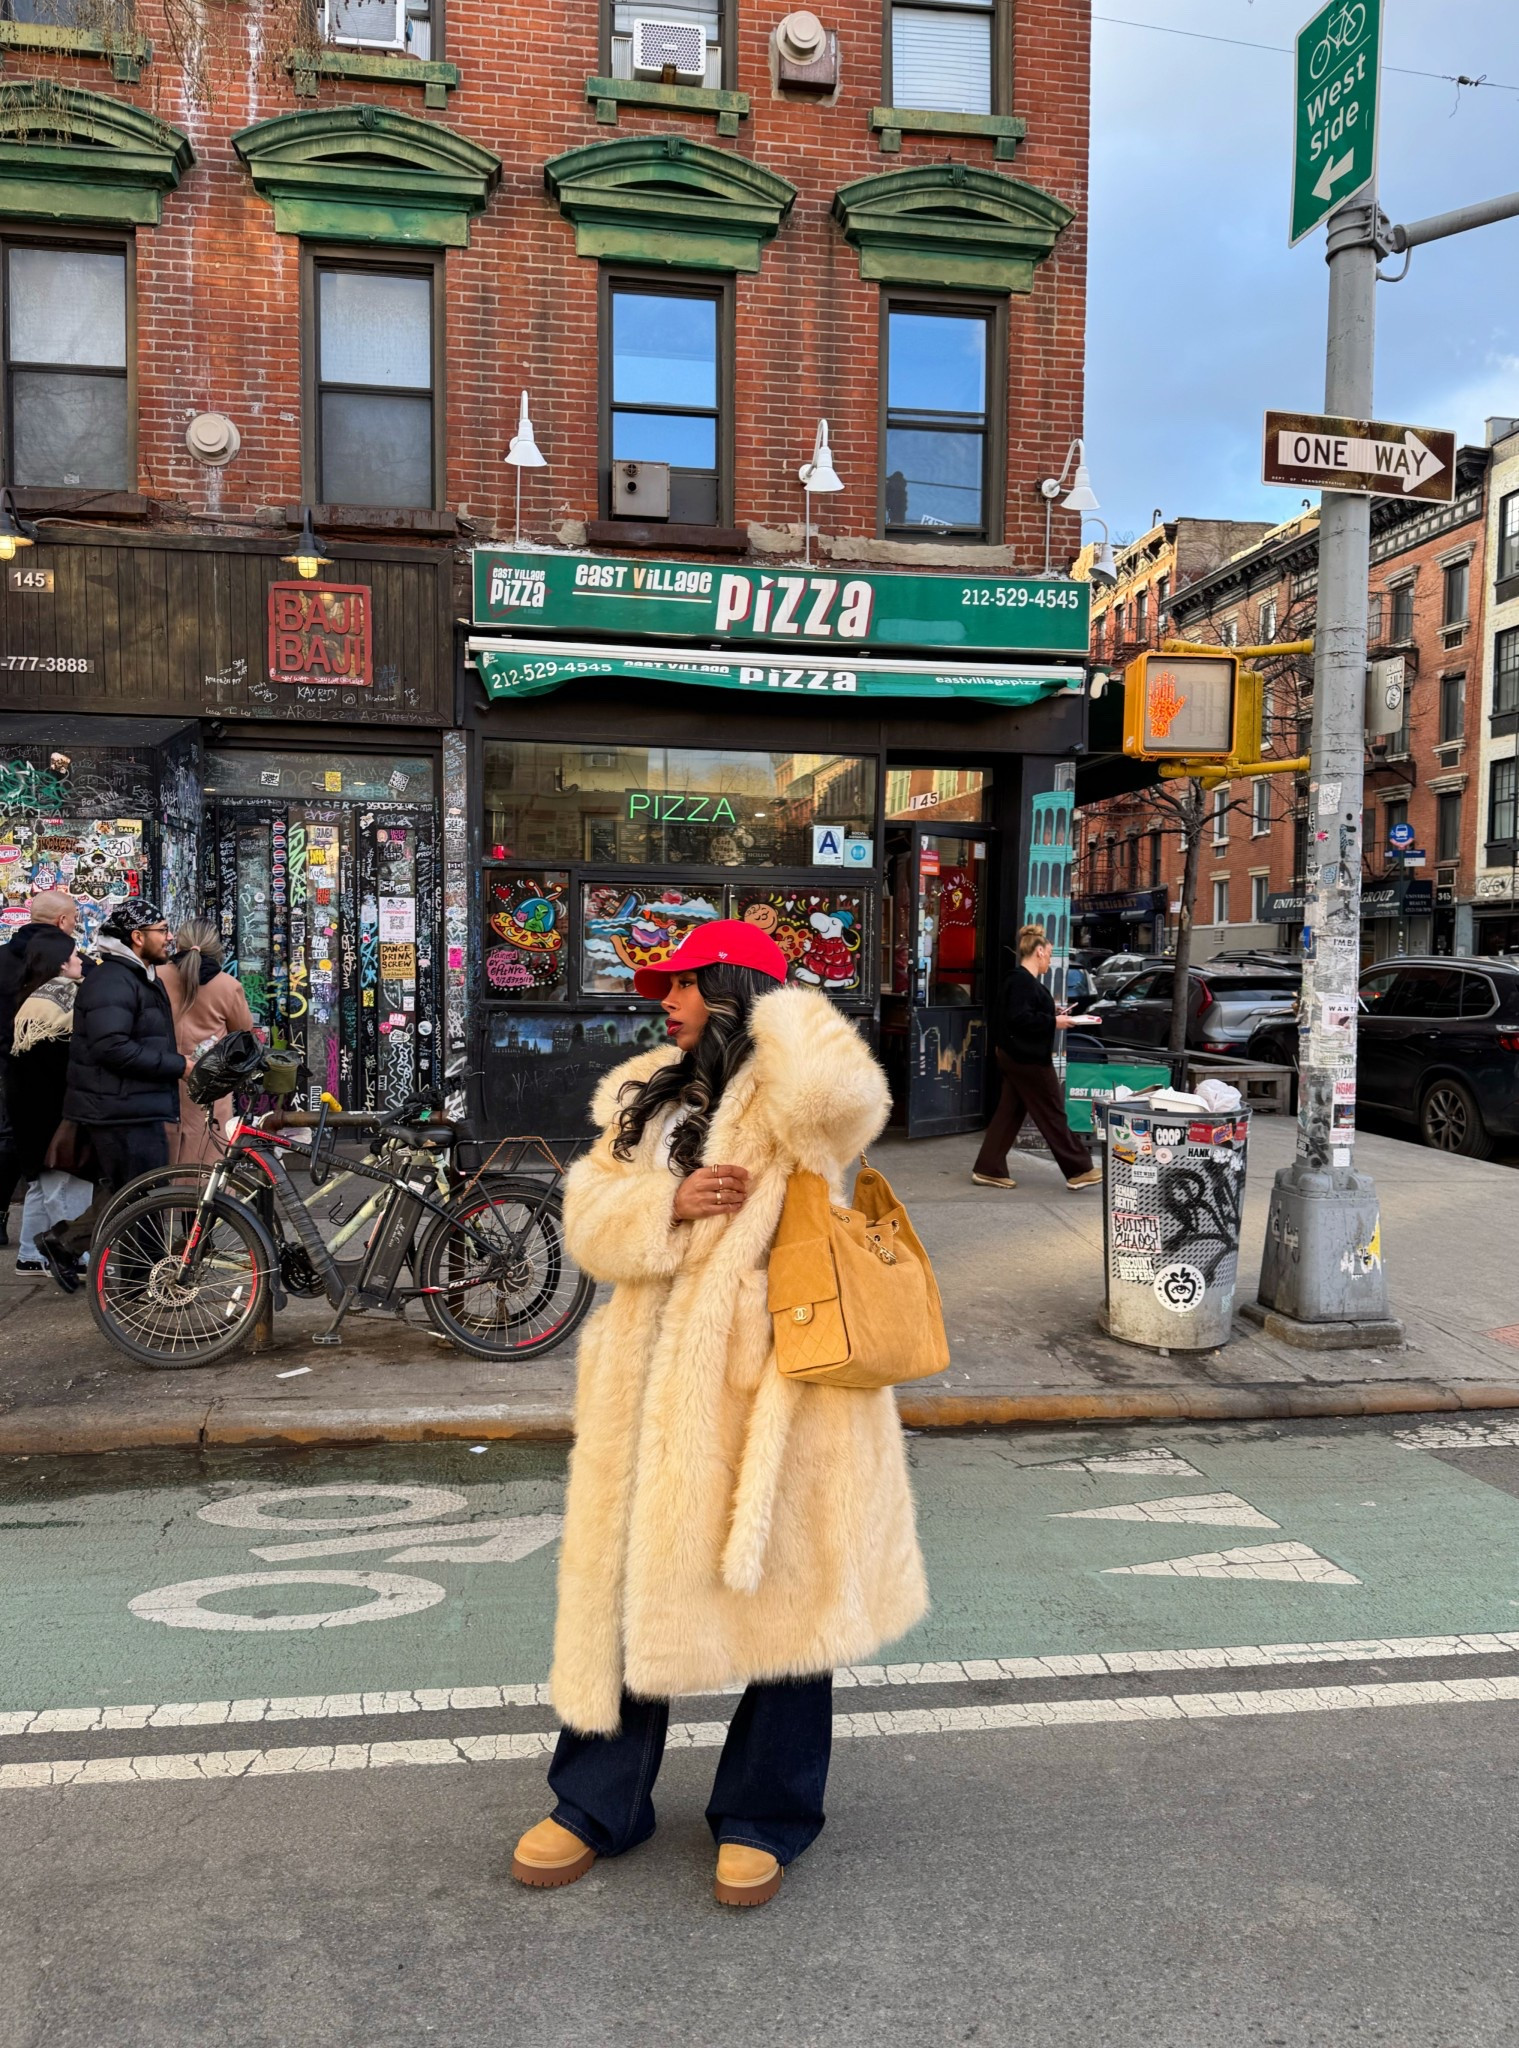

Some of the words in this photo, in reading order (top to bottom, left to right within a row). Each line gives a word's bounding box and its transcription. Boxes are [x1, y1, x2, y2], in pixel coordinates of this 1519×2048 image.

[1307, 52, 1366, 128] West
[1310, 101, 1360, 162] Side
[1293, 436, 1348, 467] ONE
[1375, 444, 1428, 477] WAY
[1301, 478, 1347, 487] TRANSPORTATION
[13, 571, 45, 588] 145
[961, 587, 1079, 609] 212-529-4545
[279, 594, 361, 635] BAJI
[279, 634, 361, 675] BAJI
[491, 661, 613, 689] 212-529-4545
[629, 793, 736, 823] PIZZA
[911, 791, 938, 809] 145
[818, 831, 839, 854] A
[1360, 889, 1395, 903] GROUP
[382, 960, 412, 968] SCREW
[1155, 1128, 1181, 1145] COOP
[1188, 1147, 1210, 1157] HANK
